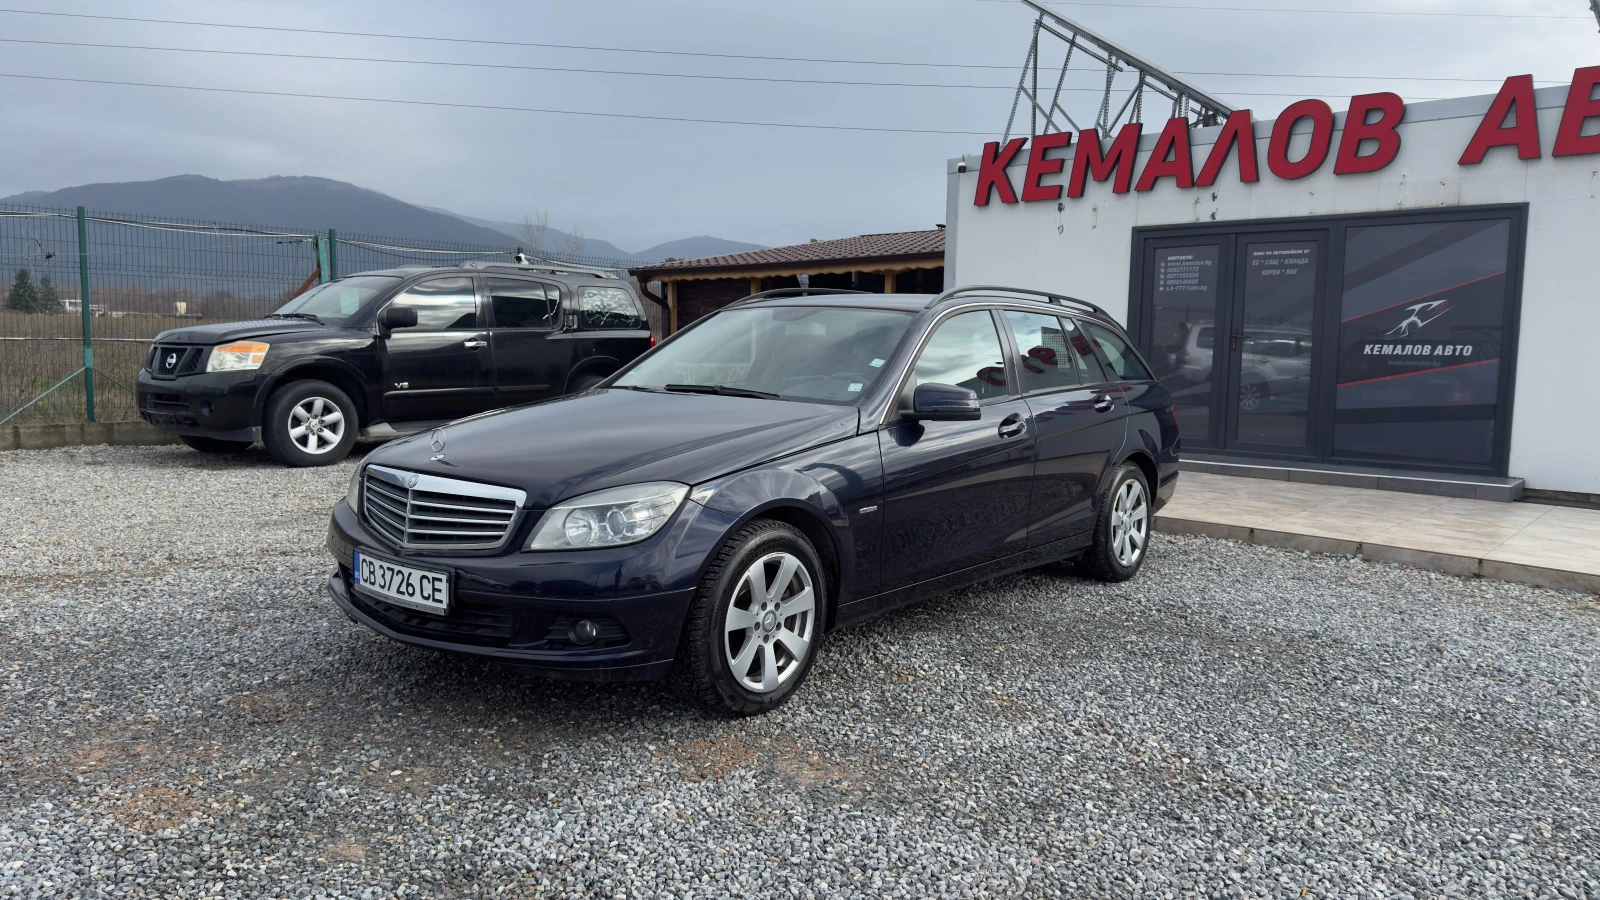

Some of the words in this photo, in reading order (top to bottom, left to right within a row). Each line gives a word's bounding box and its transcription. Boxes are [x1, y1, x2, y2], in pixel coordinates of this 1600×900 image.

[974, 92, 1406, 206] КЕМАЛОВ
[1363, 344, 1431, 355] КЕМАЛОВ
[1433, 345, 1473, 356] АВТО
[361, 558, 376, 586] CB
[379, 564, 415, 597] 3726
[420, 574, 443, 604] CE
